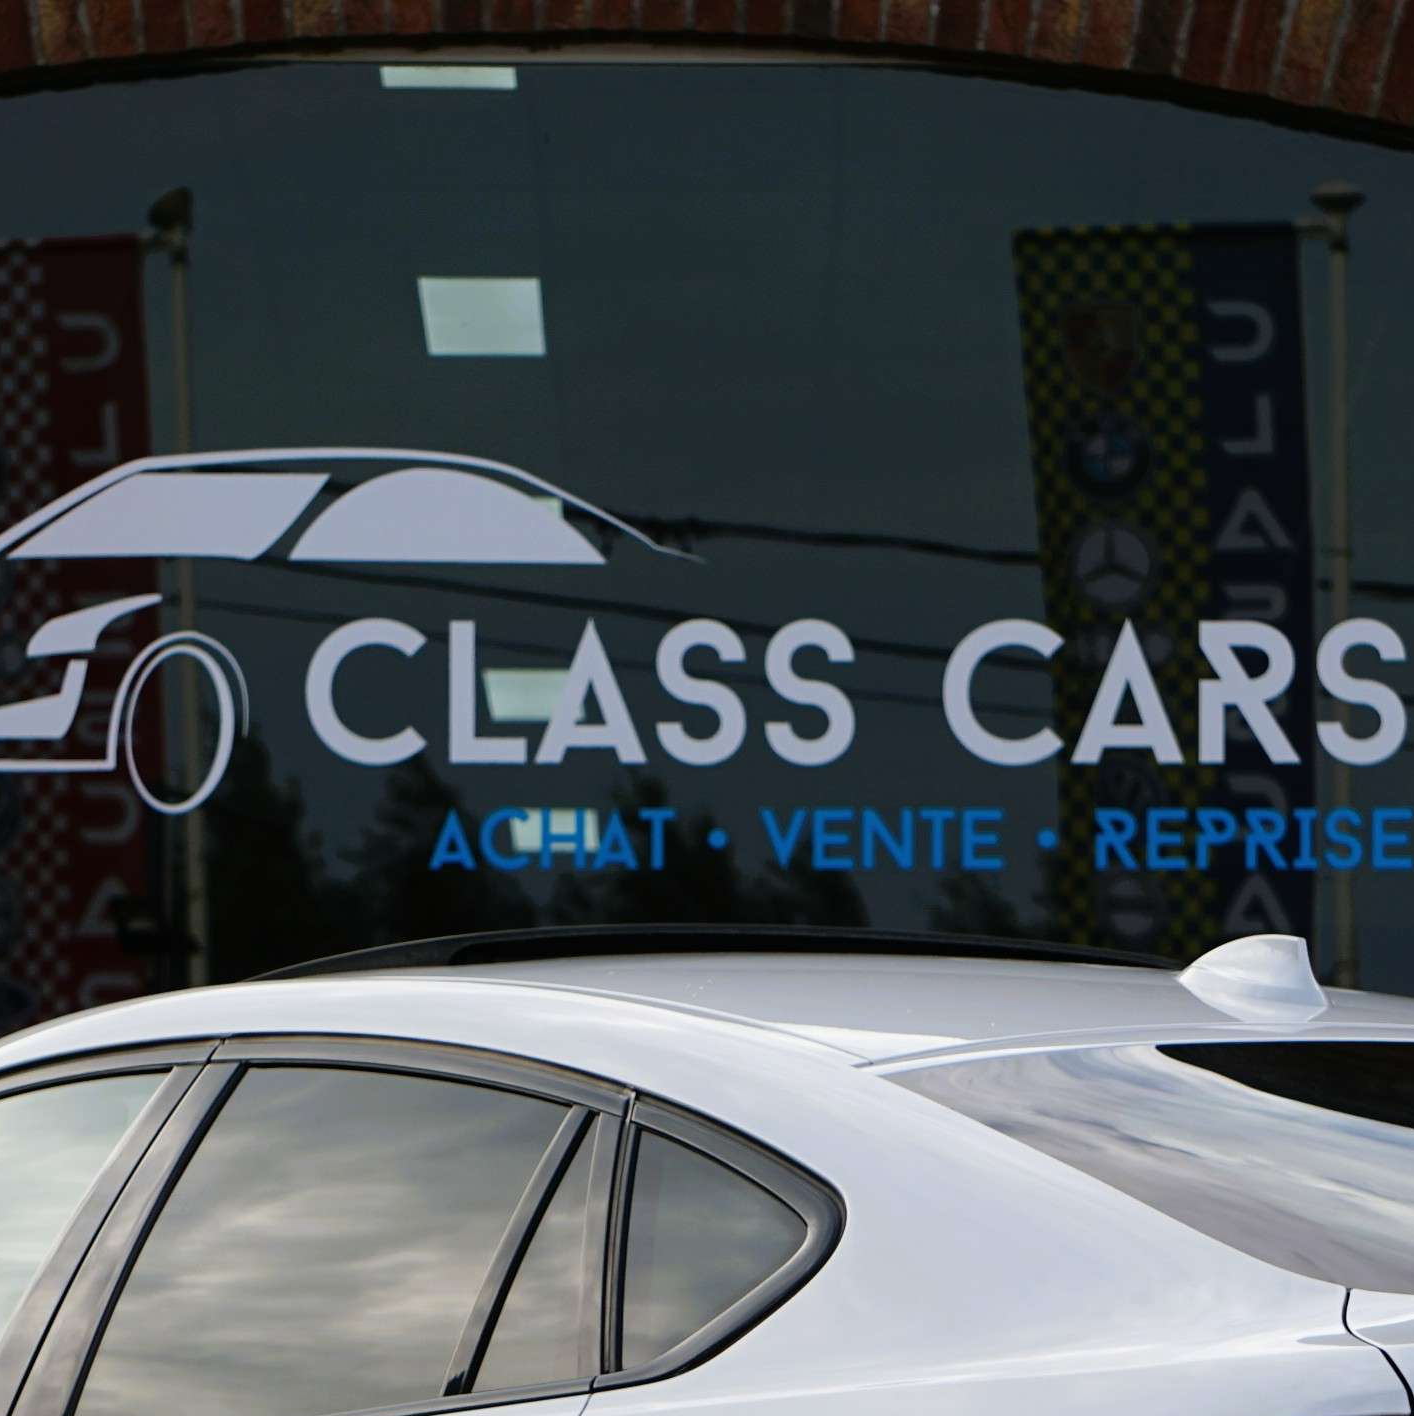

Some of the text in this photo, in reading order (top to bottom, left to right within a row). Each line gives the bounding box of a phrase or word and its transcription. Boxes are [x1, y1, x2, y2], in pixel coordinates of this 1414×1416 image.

[304, 617, 1409, 766] CLASS CARS
[428, 807, 1414, 871] ACHAT VENTE REPRISE
